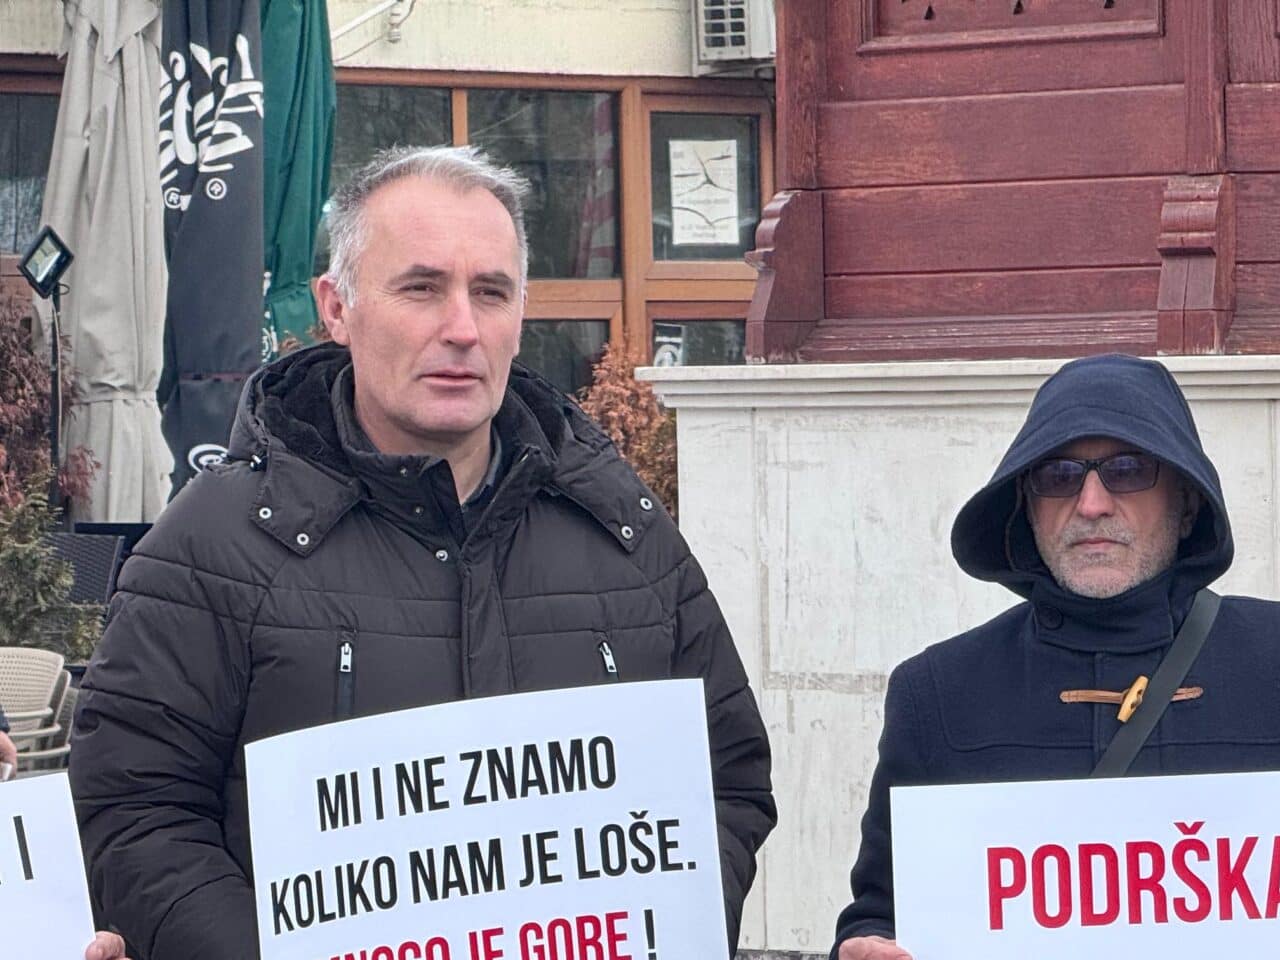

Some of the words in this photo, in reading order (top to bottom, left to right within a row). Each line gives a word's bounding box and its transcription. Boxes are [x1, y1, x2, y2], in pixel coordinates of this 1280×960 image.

[316, 770, 362, 832] MI
[372, 766, 384, 820] I
[394, 756, 450, 816] NE
[460, 735, 617, 805] ZNAMO
[270, 855, 398, 935] KOLIKO
[410, 838, 505, 903] NAM
[519, 830, 563, 888] JE
[574, 810, 697, 880] LOŠE.
